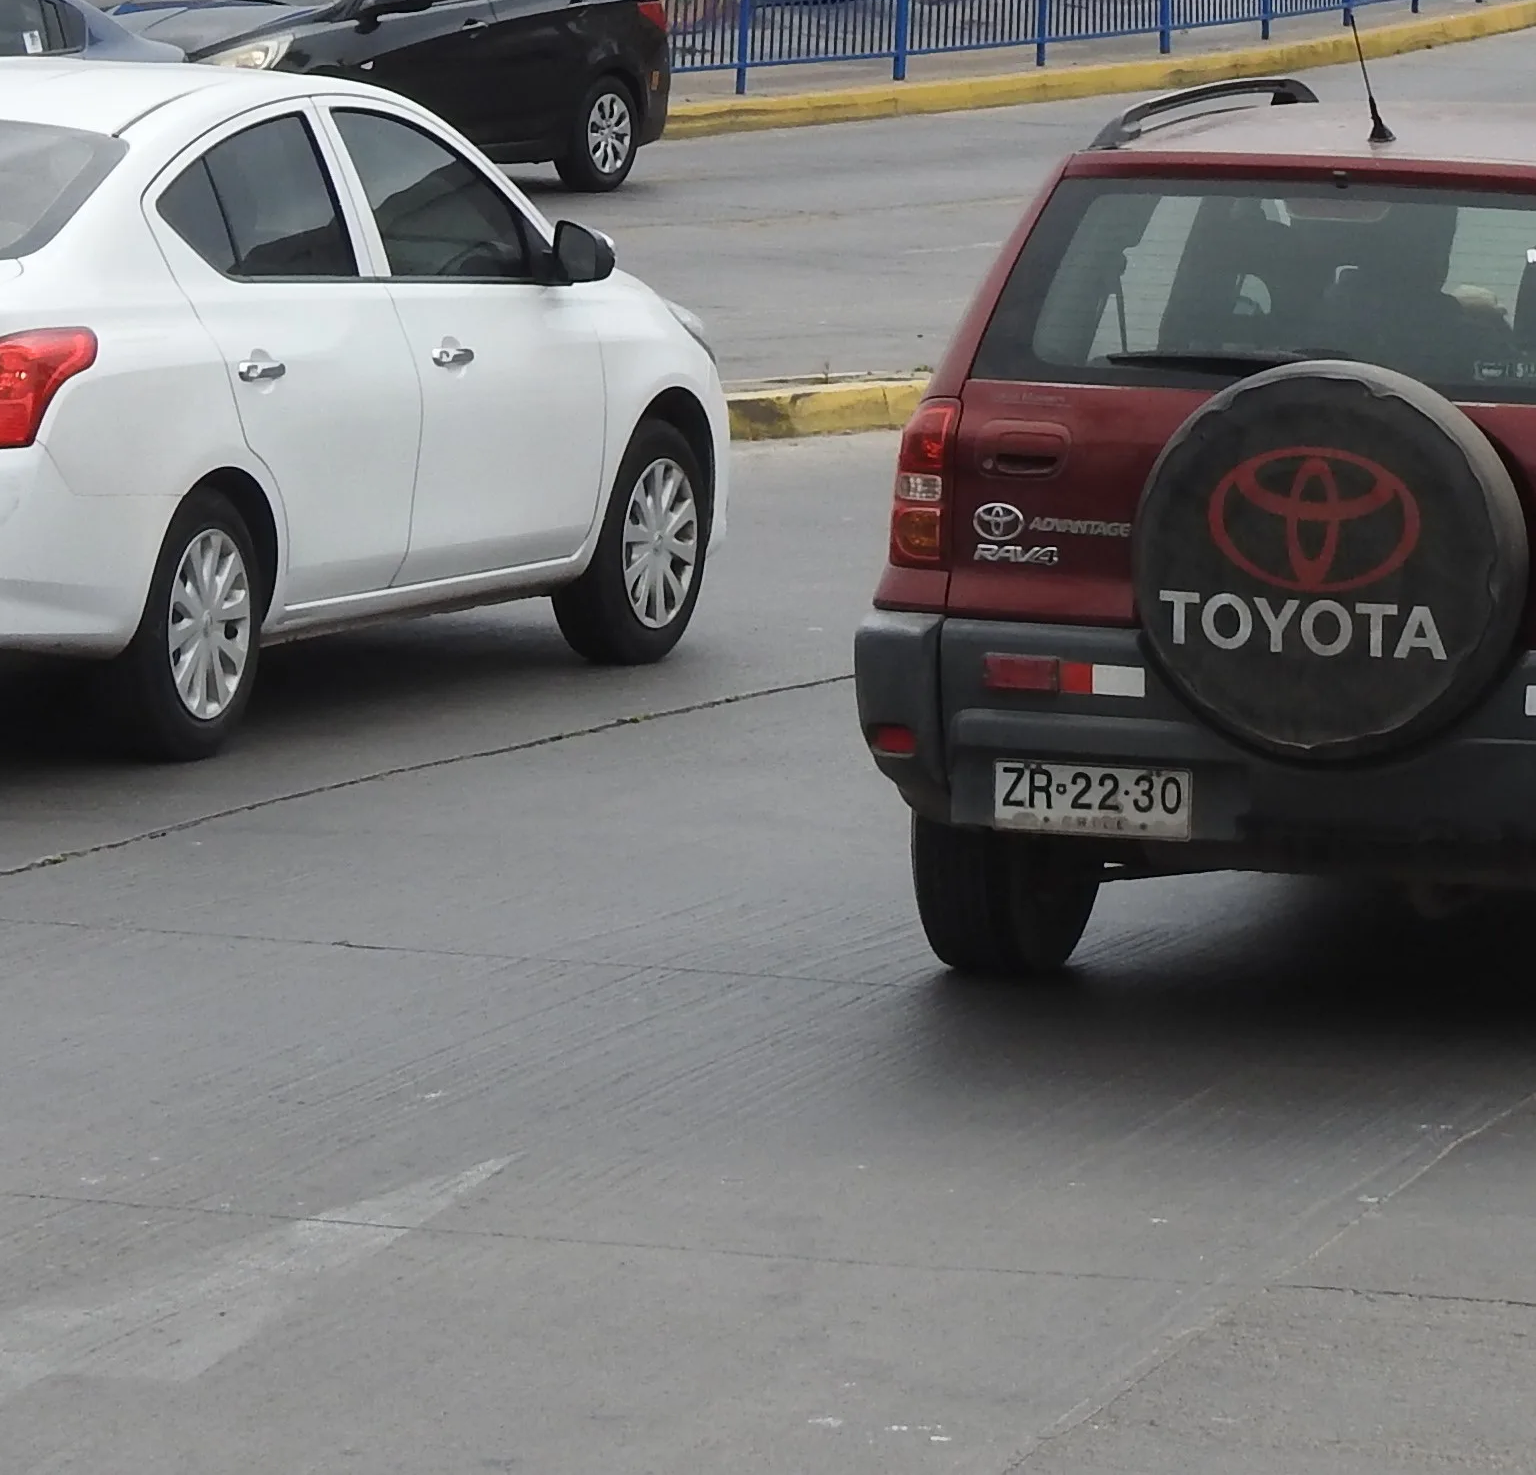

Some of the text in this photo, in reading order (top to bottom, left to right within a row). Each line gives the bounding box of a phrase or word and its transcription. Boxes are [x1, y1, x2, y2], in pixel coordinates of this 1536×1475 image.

[1028, 516, 1132, 538] ADVANTAGE
[973, 543, 1060, 566] RAV4
[1158, 588, 1449, 662] TOYOTA
